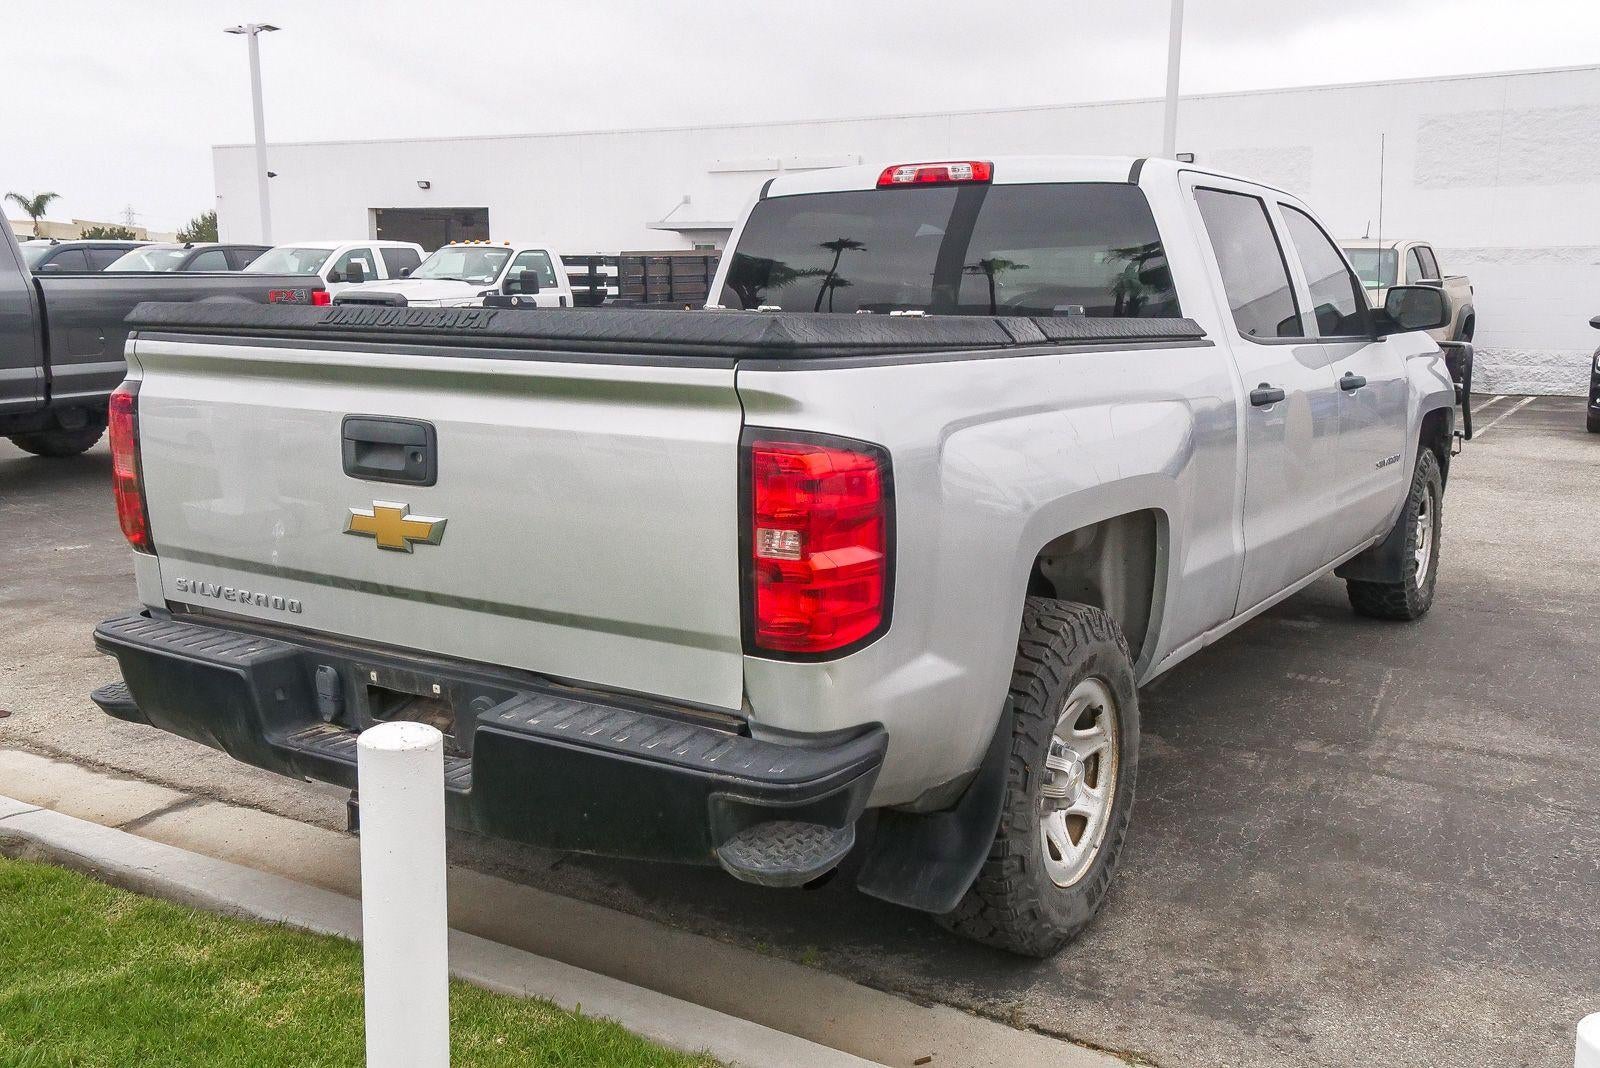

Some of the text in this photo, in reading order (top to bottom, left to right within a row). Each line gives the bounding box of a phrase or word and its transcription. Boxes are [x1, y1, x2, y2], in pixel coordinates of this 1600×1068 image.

[269, 289, 308, 304] FX4
[319, 307, 498, 329] DIAMONDBACK
[176, 577, 302, 613] SILVERADO
